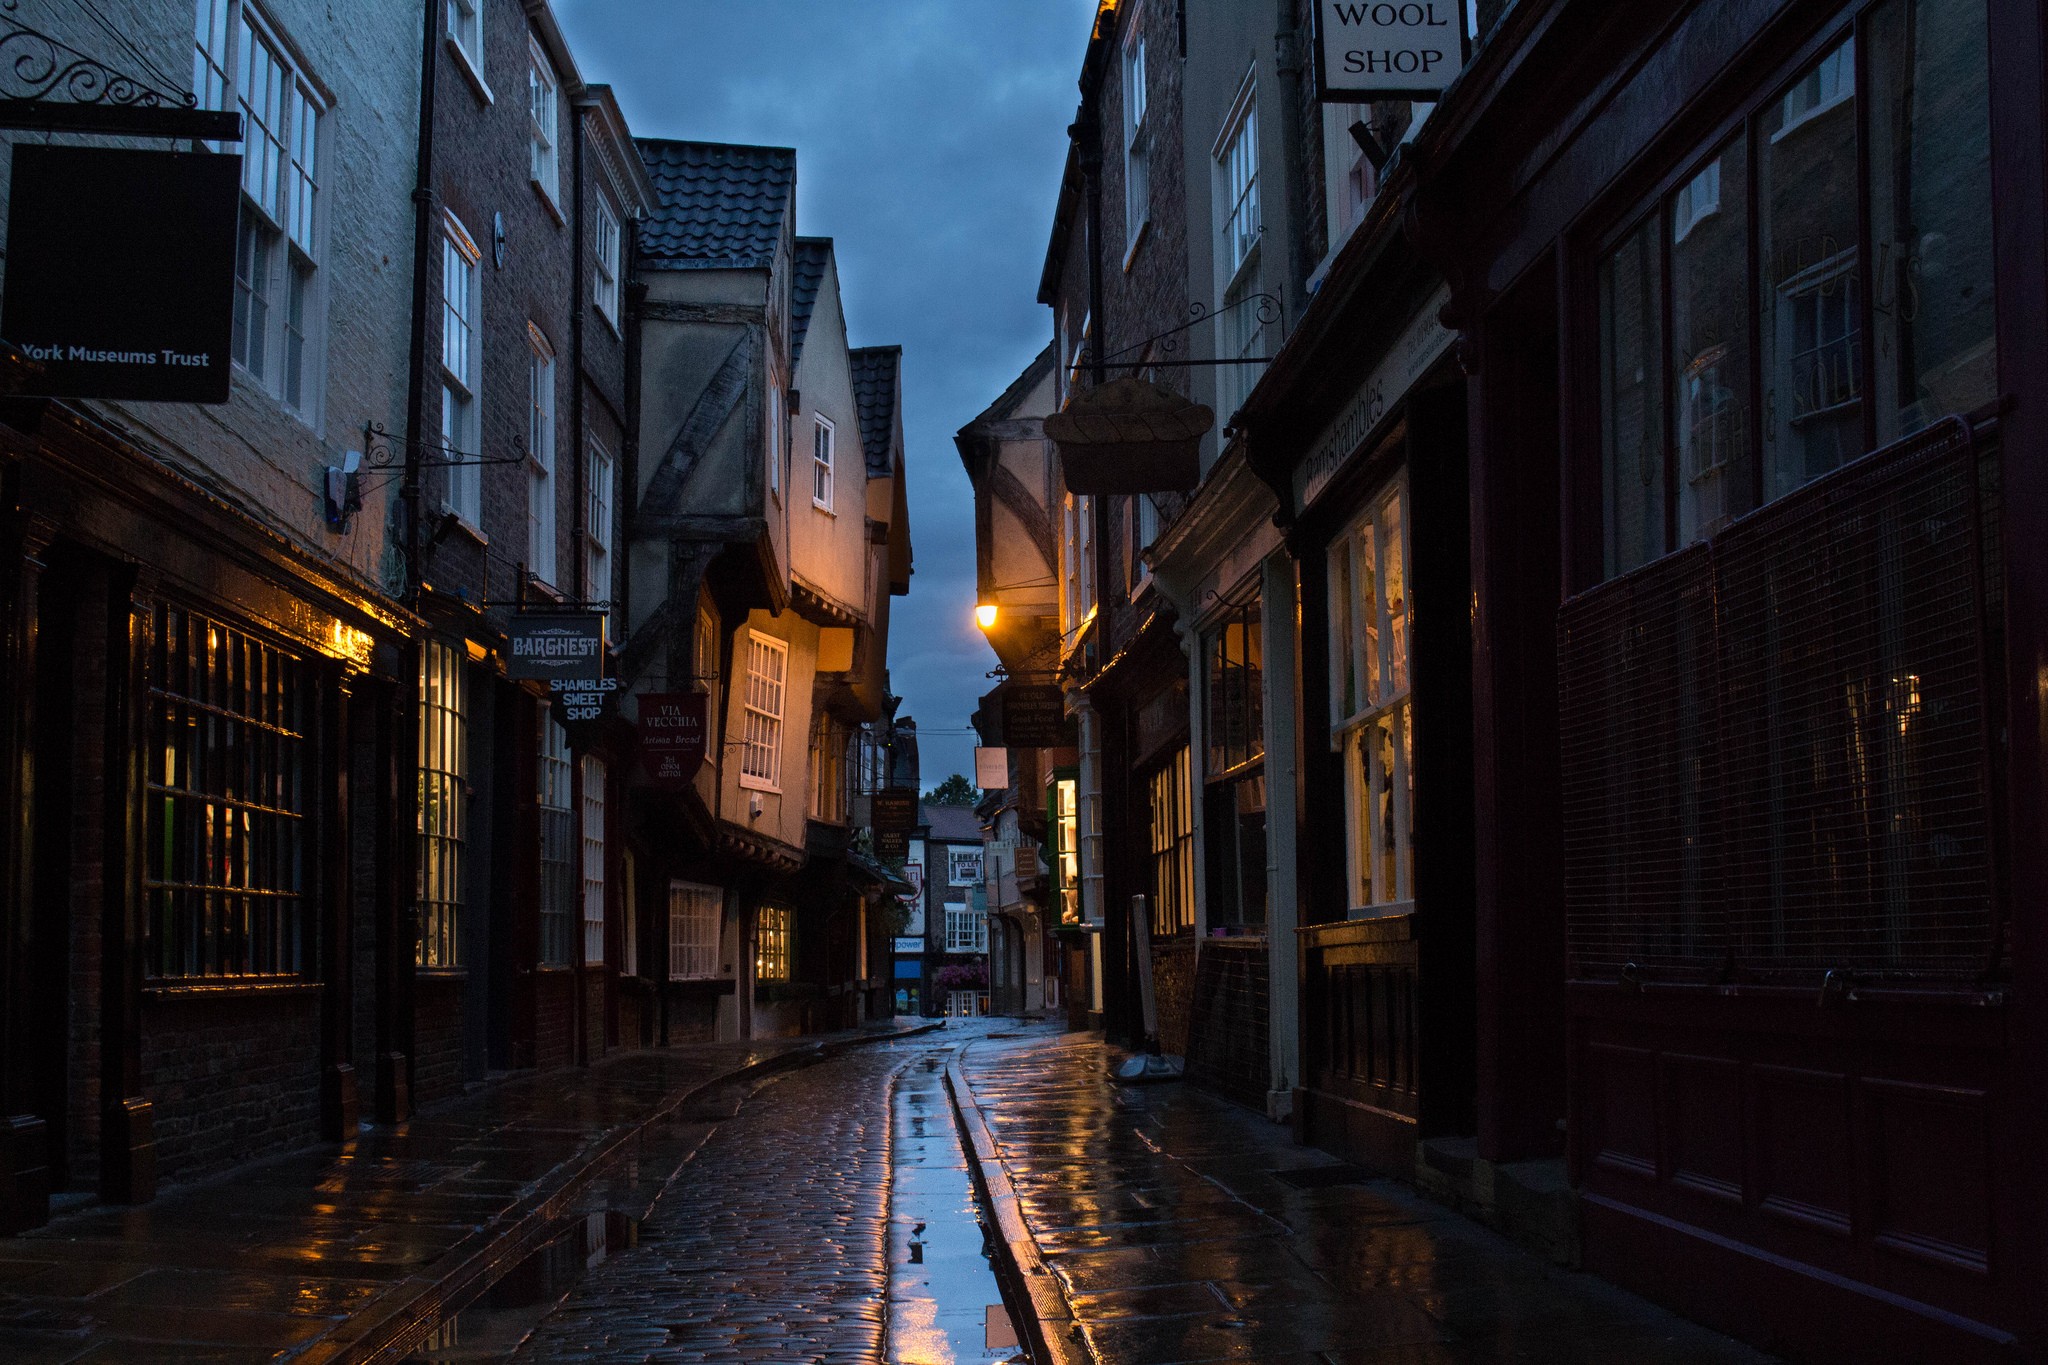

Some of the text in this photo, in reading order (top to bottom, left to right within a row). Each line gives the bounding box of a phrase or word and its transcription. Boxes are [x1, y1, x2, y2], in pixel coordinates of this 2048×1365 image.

[1333, 3, 1448, 27] WOOL
[1343, 50, 1443, 73] SHOP
[21, 343, 210, 367] York Museums Trust
[1305, 378, 1384, 498] Ramshambles
[513, 637, 598, 657] BARGHEST
[550, 678, 617, 692] SHAMBLES
[562, 692, 605, 706] SWEET
[566, 707, 602, 720] SHOP
[660, 705, 681, 716] VIA
[646, 716, 698, 727] VECCHIA
[675, 734, 701, 744] Bread
[895, 941, 922, 950] power
